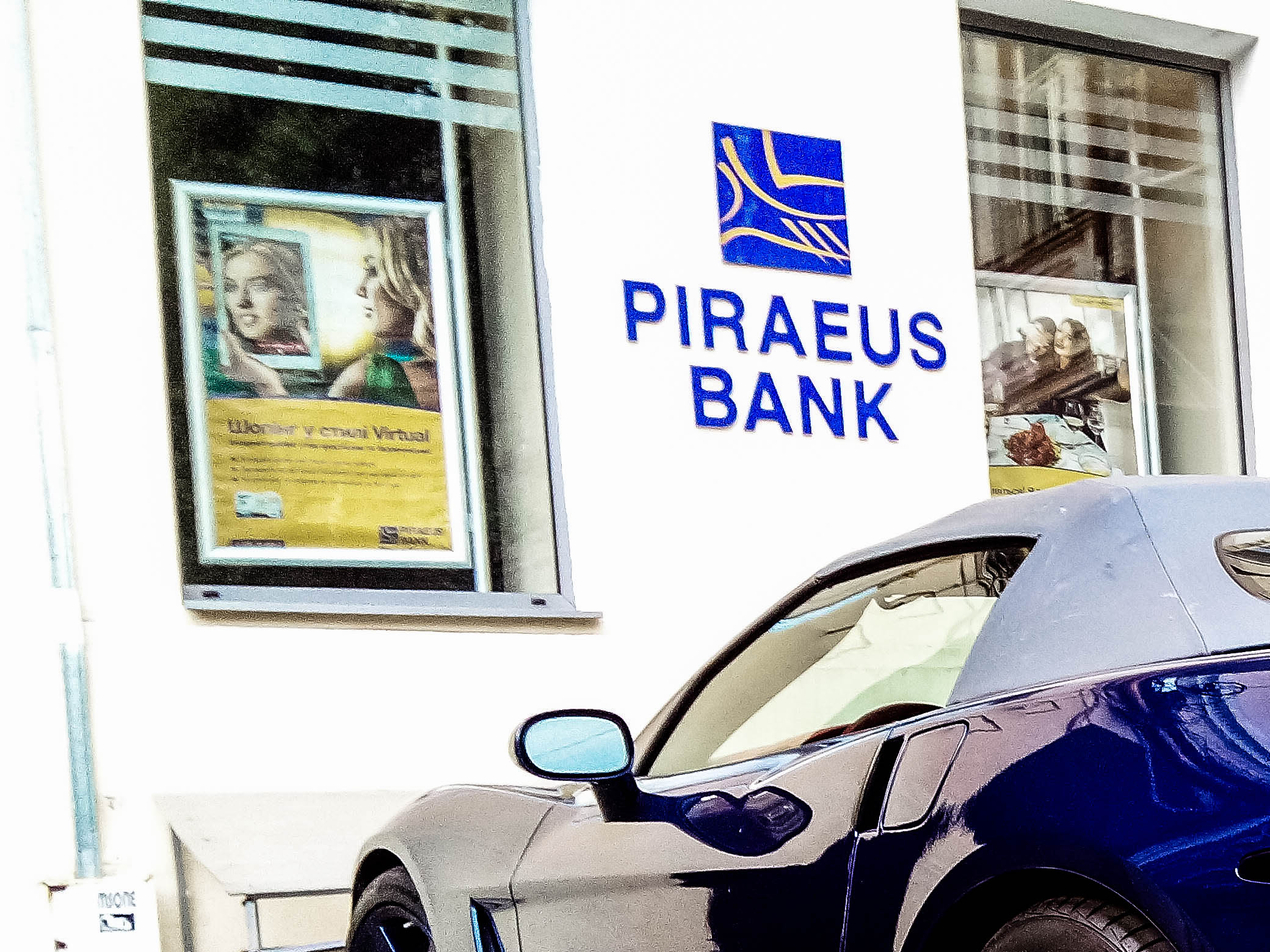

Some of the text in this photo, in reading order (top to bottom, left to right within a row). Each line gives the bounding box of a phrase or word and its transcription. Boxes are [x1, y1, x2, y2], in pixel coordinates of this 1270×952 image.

[622, 278, 947, 372] PIRAEUS
[371, 424, 431, 443] Virtual
[690, 364, 899, 443] BANK
